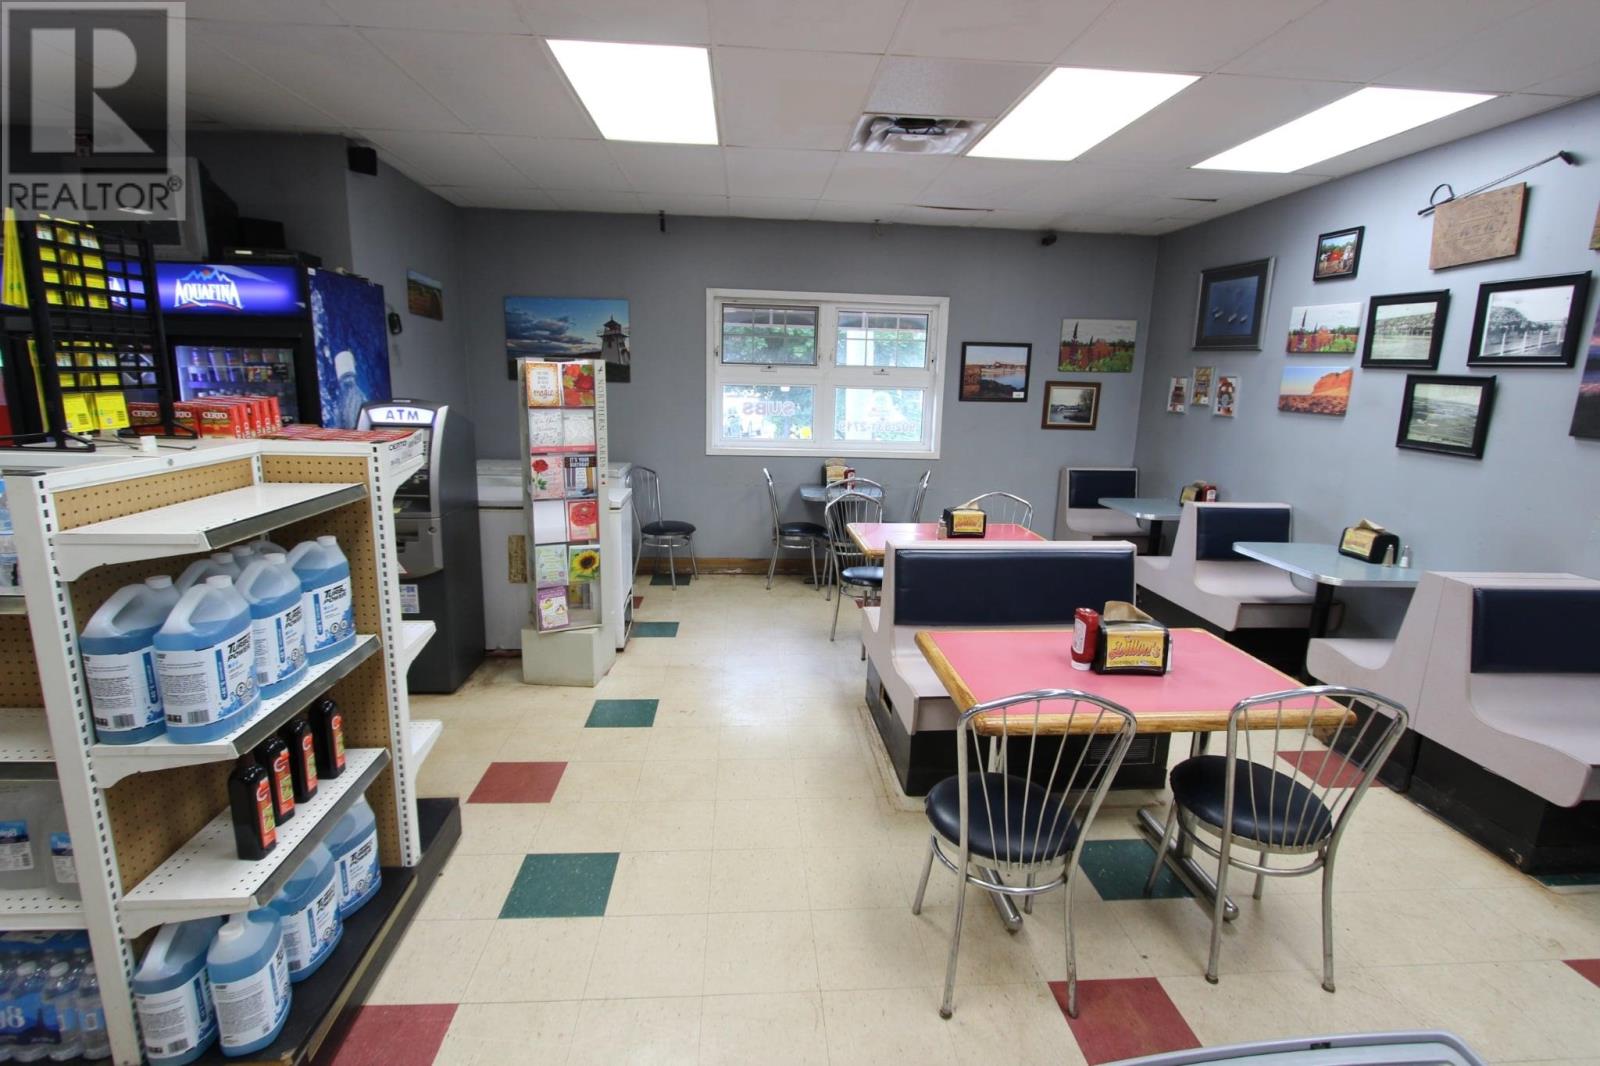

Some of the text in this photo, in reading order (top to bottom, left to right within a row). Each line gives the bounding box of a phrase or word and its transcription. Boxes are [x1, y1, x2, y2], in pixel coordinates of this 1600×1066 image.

[174, 279, 243, 309] AQUAFINA
[131, 410, 158, 418] CERTO
[202, 411, 228, 420] CERTO
[385, 409, 420, 421] ATM
